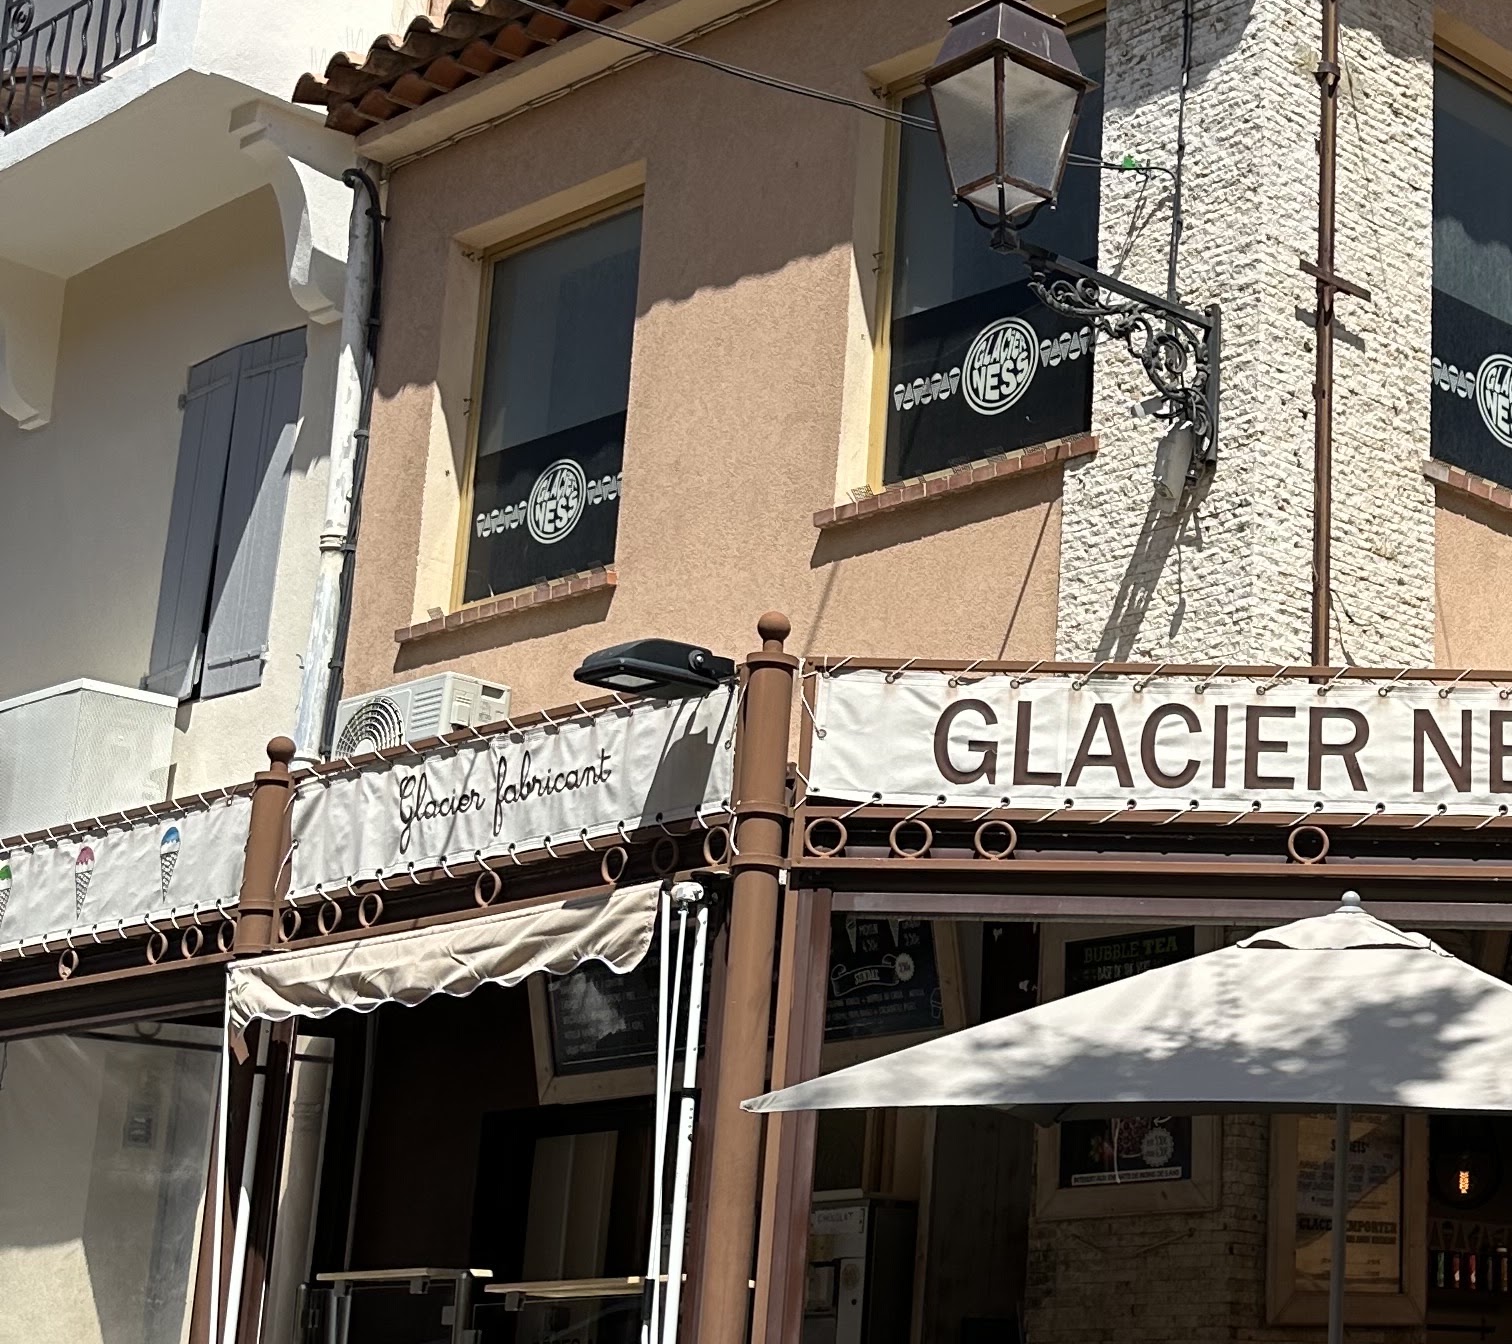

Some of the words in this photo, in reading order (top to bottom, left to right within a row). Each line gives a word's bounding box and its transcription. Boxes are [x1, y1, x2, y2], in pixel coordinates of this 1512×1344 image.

[972, 351, 1029, 401] NESS
[535, 491, 579, 533] NESS
[932, 699, 1370, 792] GLACIER
[399, 772, 486, 855] Glacier
[493, 747, 612, 837] fabricant
[1084, 941, 1139, 964] BUBBLE
[1142, 935, 1178, 955] TEA
